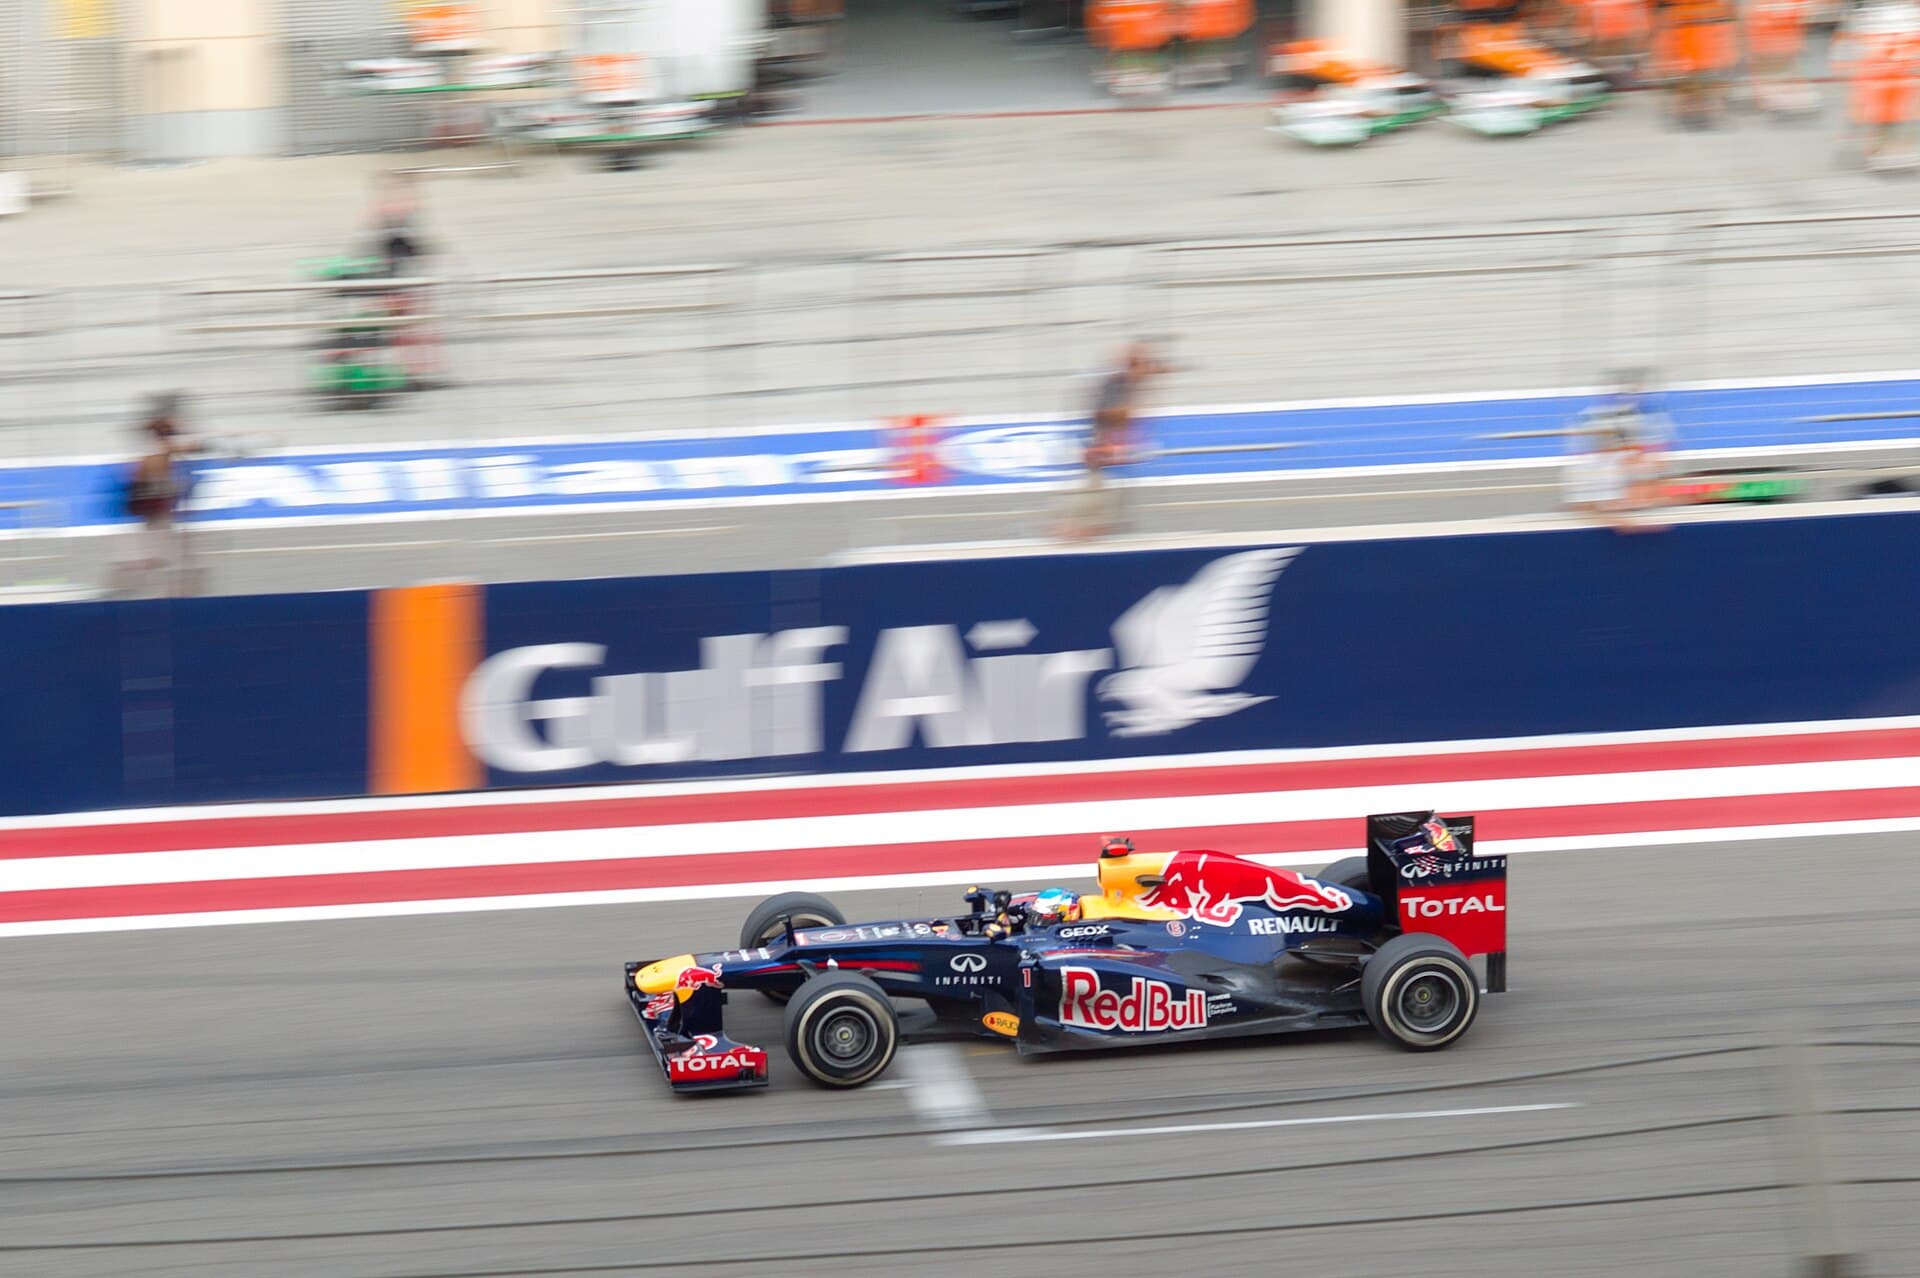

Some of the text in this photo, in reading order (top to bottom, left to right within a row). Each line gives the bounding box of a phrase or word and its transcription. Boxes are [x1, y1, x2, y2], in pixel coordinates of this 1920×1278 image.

[458, 617, 1113, 772] Gulf Air
[1435, 859, 1506, 873] NFINITI
[1400, 895, 1505, 918] TOTAL
[1060, 924, 1110, 938] GEOX
[1247, 916, 1343, 935] RENAULT
[935, 975, 1001, 986] INFINITI
[1022, 968, 1031, 988] 1
[1060, 968, 1206, 1031] Red Bull
[671, 1054, 755, 1072] TOTAL
